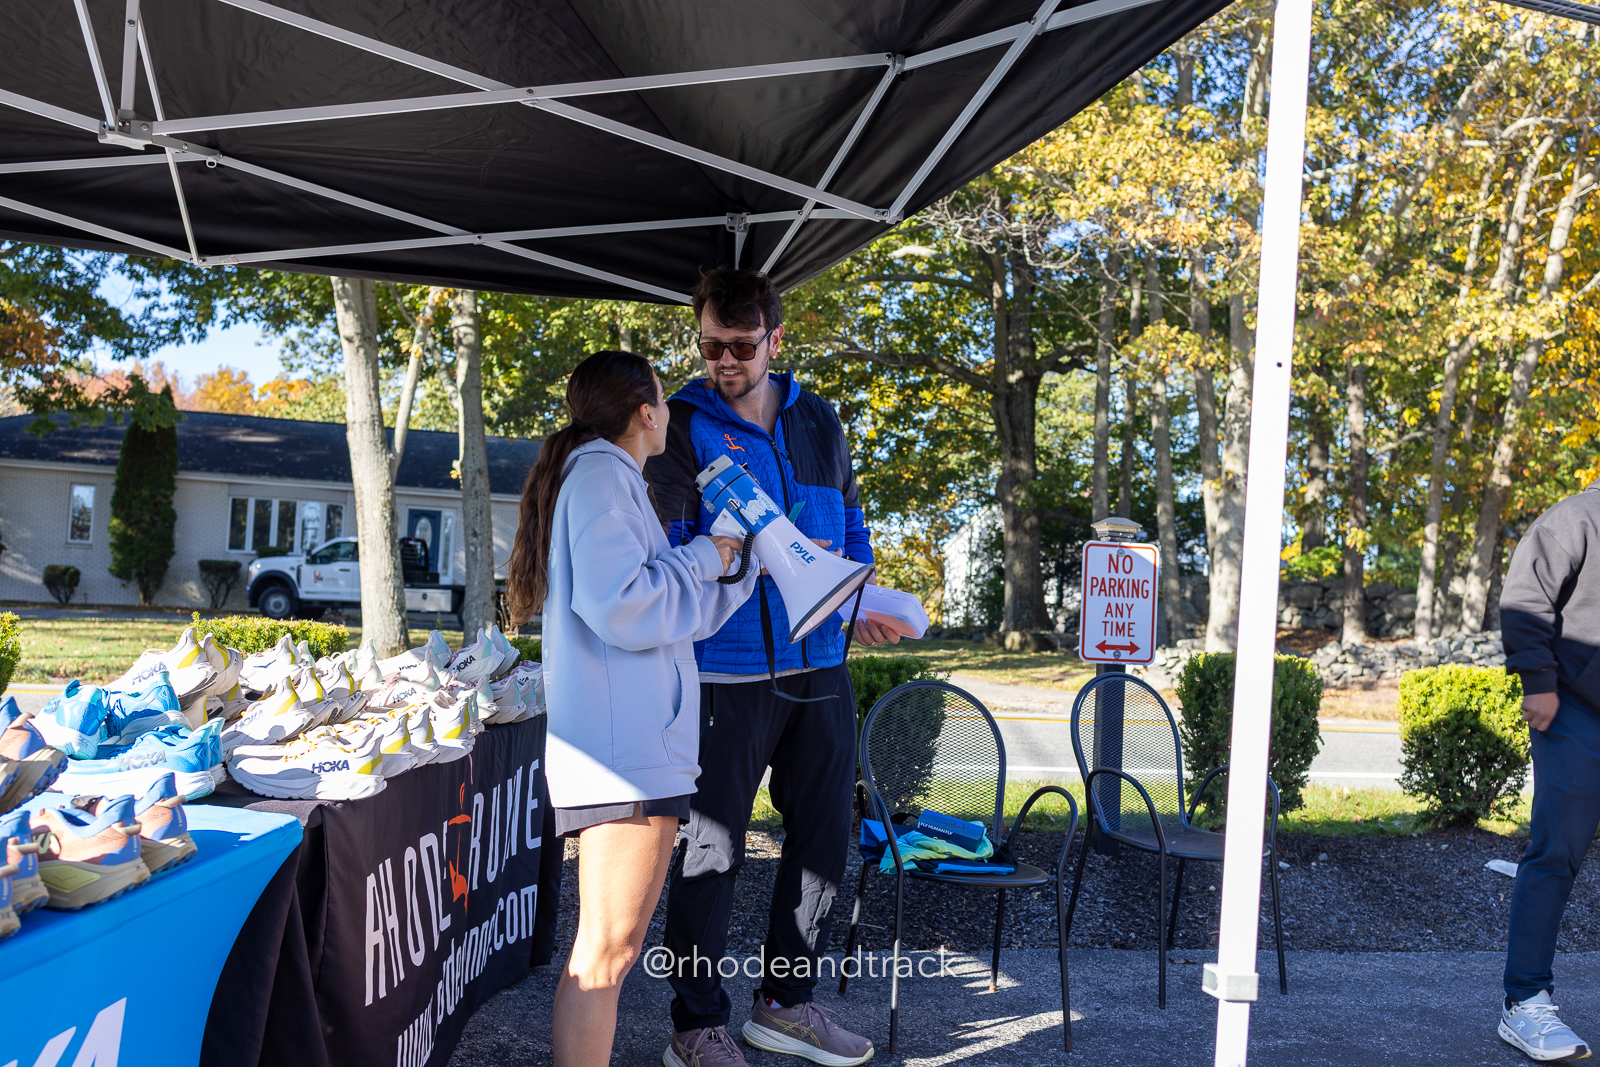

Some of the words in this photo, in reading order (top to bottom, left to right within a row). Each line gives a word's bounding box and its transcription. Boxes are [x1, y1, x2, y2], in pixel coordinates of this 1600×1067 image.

[790, 541, 816, 564] PYLE
[1108, 553, 1133, 574] NO
[1090, 576, 1149, 599] PARKING
[1104, 602, 1134, 619] ANY
[1102, 621, 1136, 637] TIME
[132, 661, 168, 685] HOKA
[393, 687, 417, 703] HOKA
[118, 750, 167, 772] HOKA
[311, 759, 350, 774] HOKA
